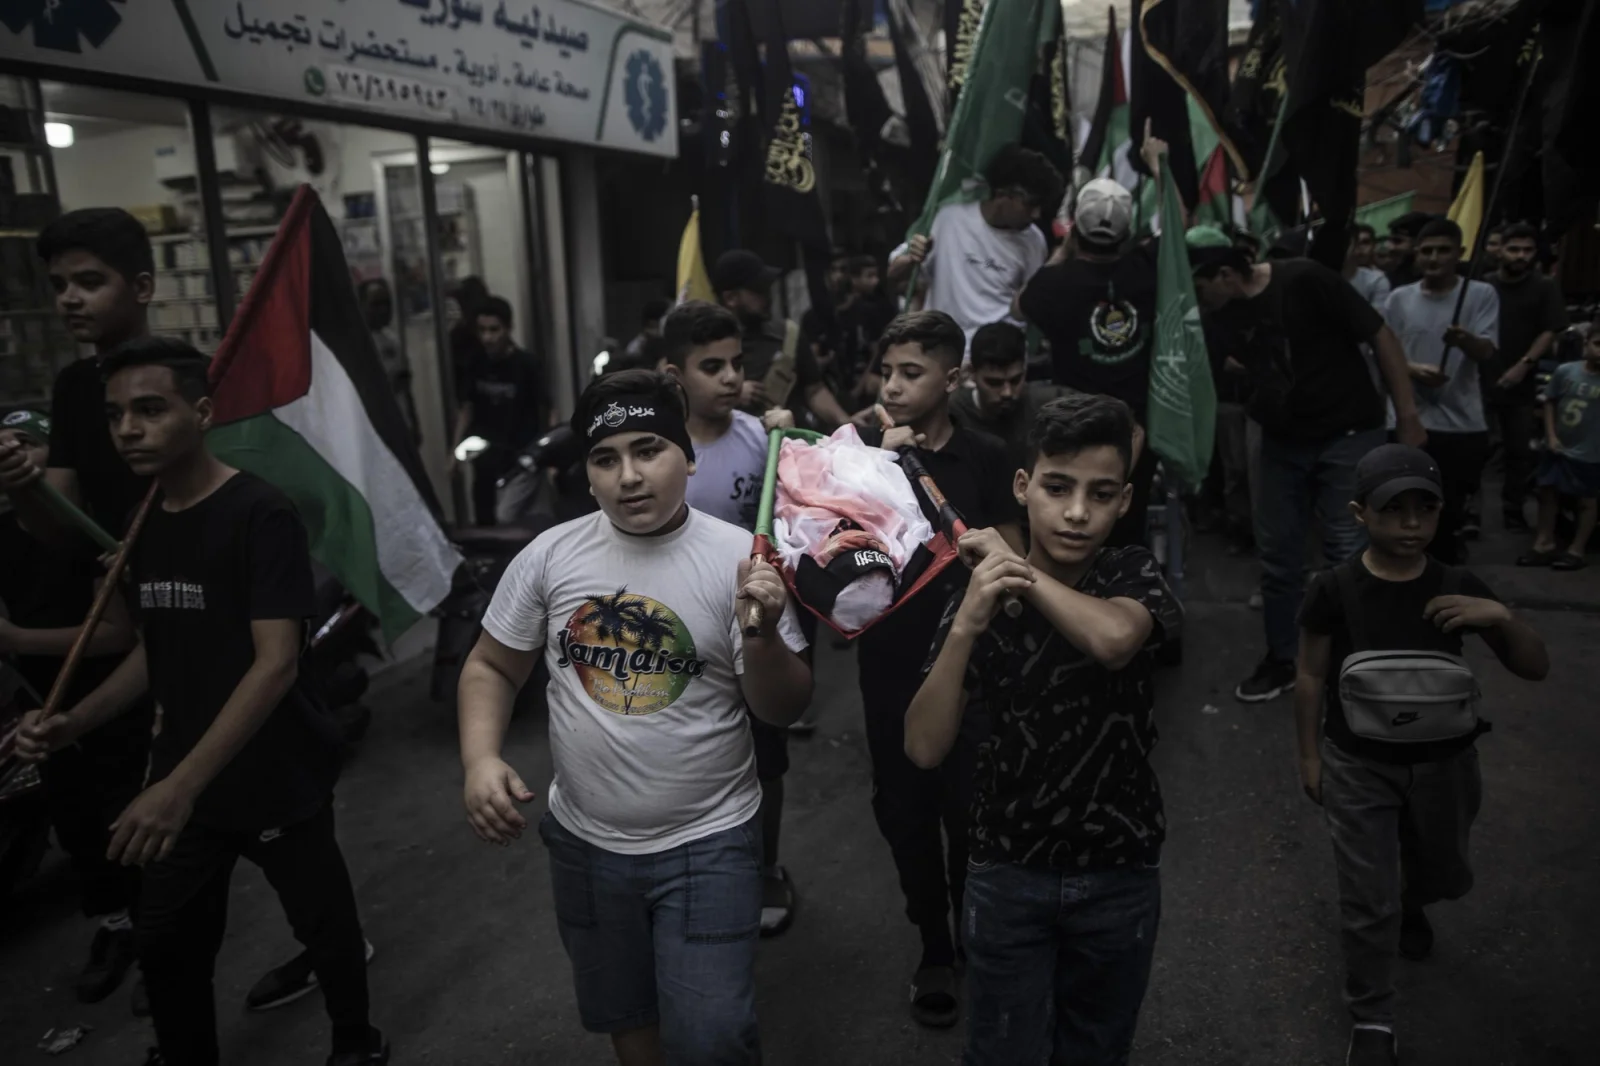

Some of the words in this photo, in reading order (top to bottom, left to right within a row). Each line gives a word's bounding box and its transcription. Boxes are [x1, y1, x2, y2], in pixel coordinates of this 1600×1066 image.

[224, 0, 311, 53] تجميل
[317, 19, 437, 68] مستحضرات
[513, 61, 551, 92] عامة
[553, 70, 590, 100] صحة
[628, 405, 656, 417] عرين
[556, 628, 708, 681] Jamaica
